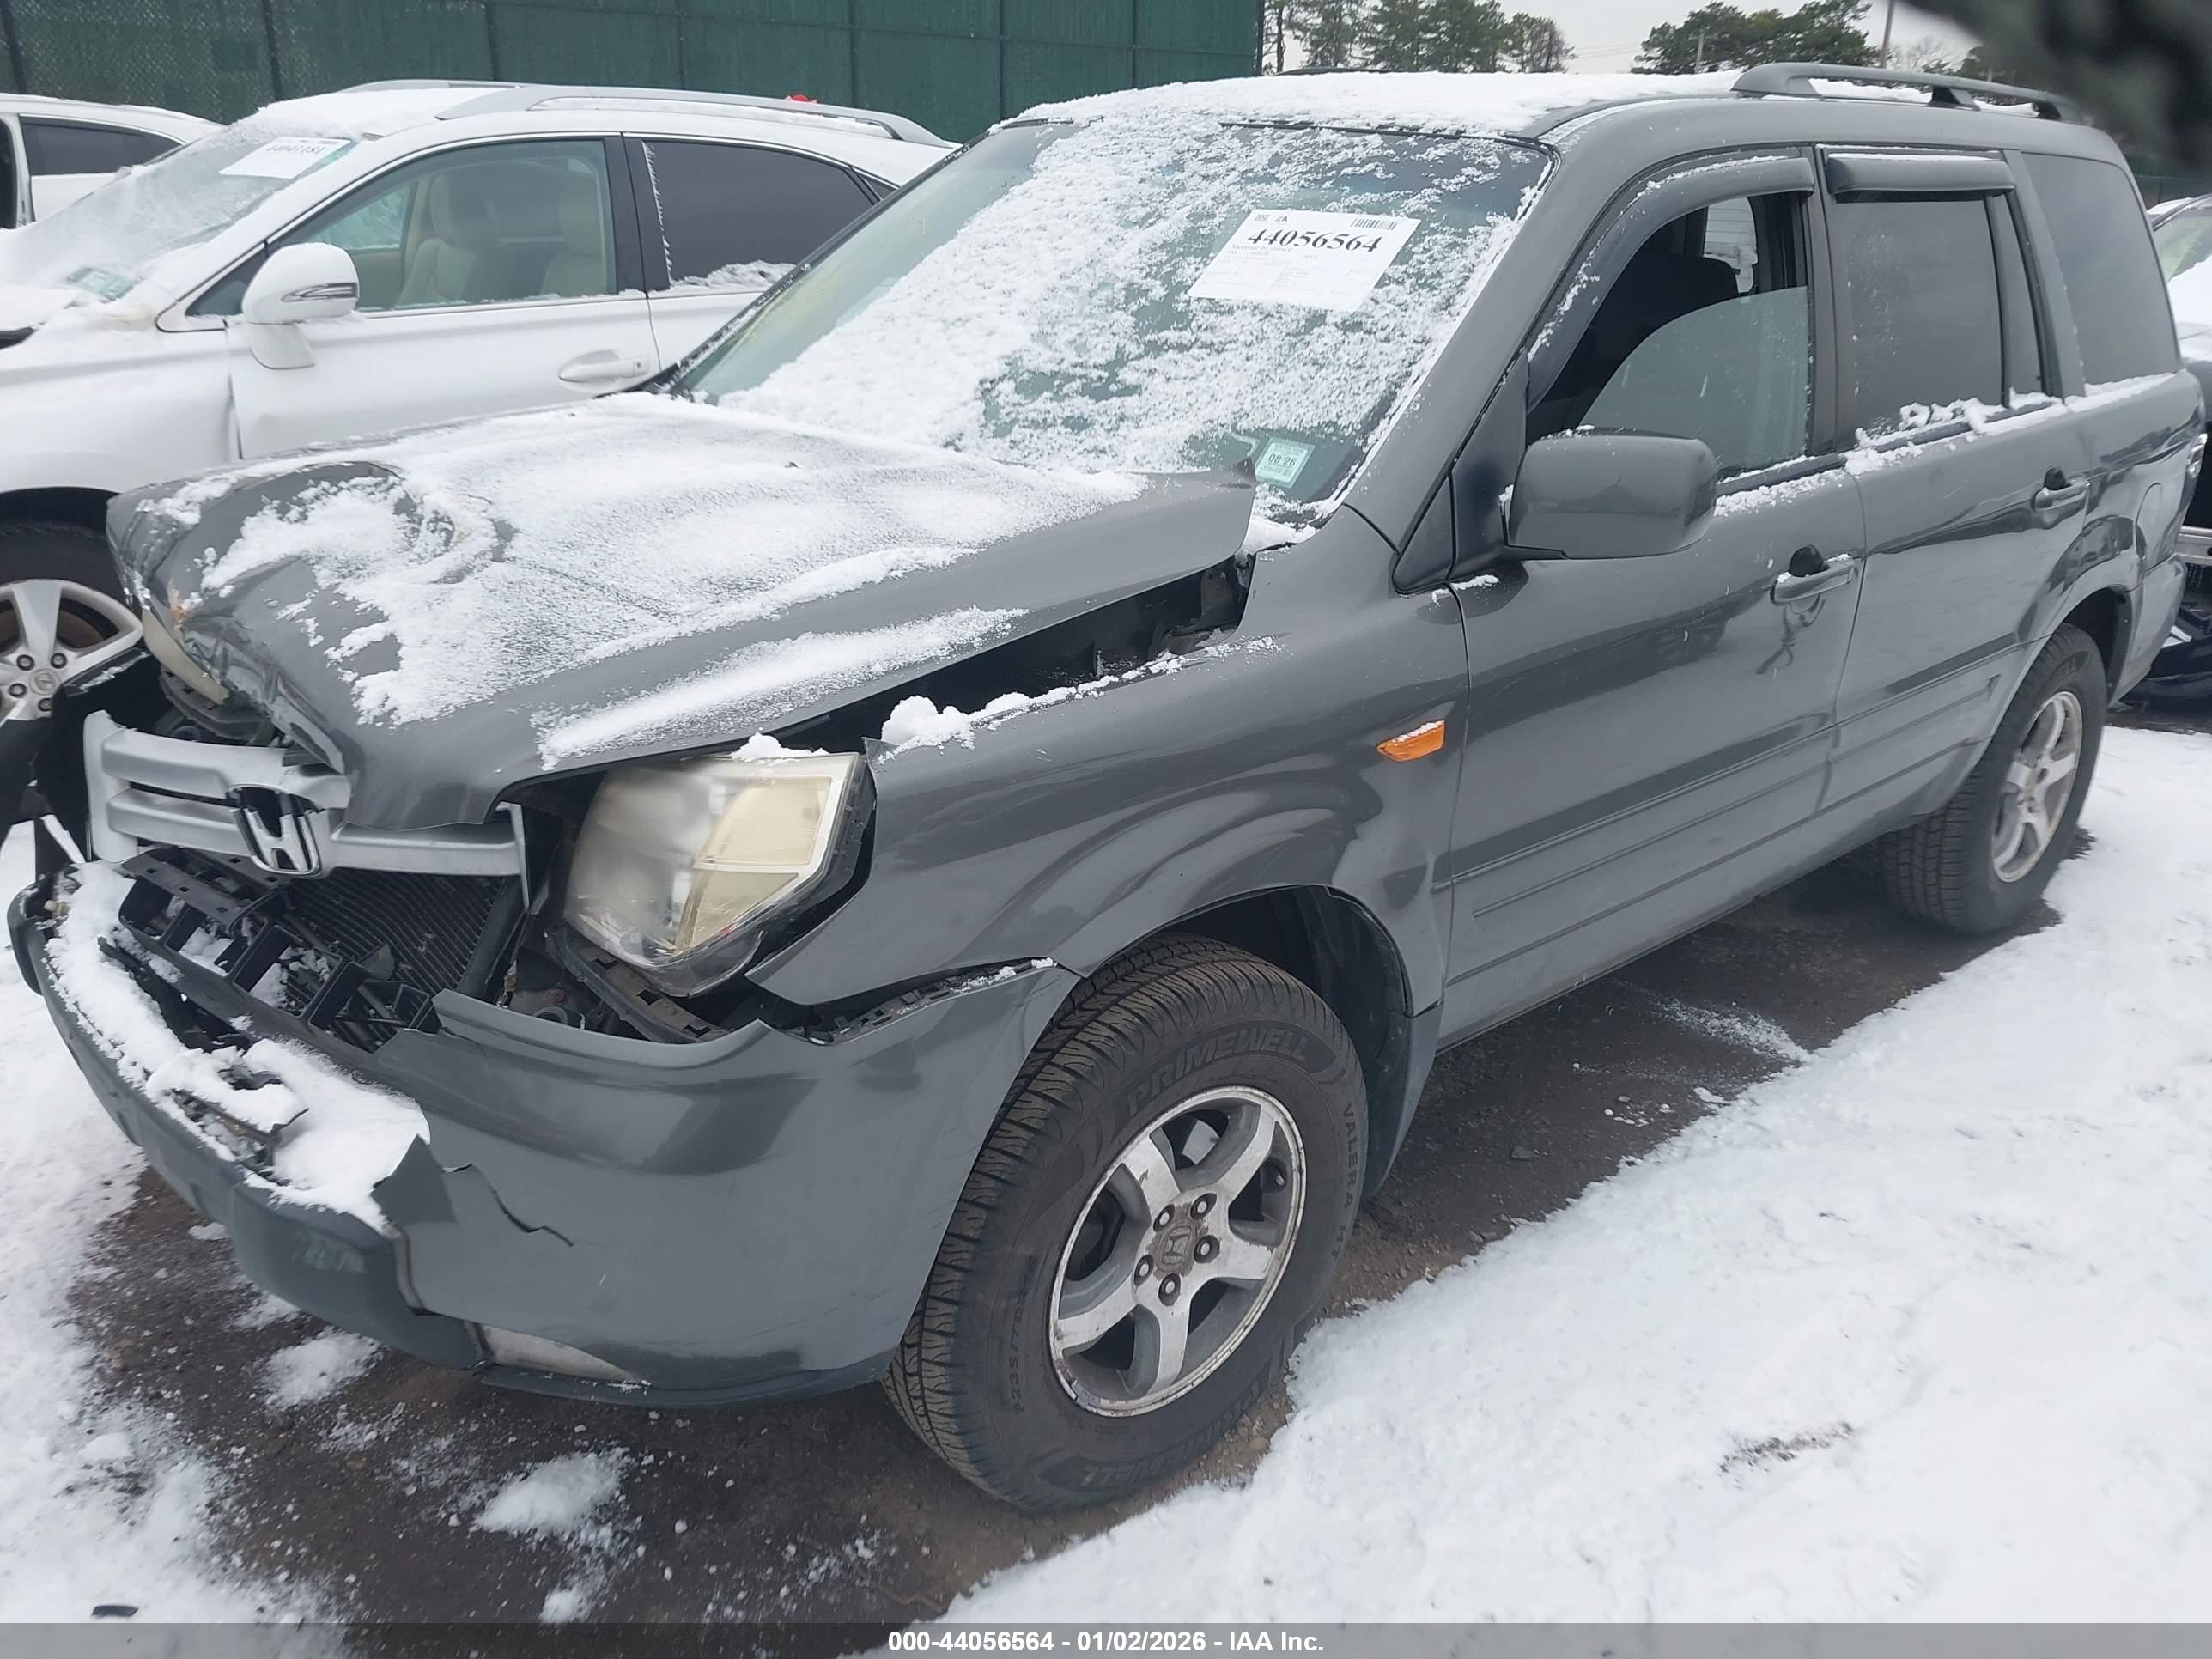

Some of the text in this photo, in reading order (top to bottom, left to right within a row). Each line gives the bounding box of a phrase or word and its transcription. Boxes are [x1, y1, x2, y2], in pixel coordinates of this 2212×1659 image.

[1248, 228, 1382, 253] 44056564
[1269, 453, 1297, 466] 08 26
[1127, 1028, 1309, 1119] PRIMEWELL
[1343, 1101, 1358, 1209] VALERA
